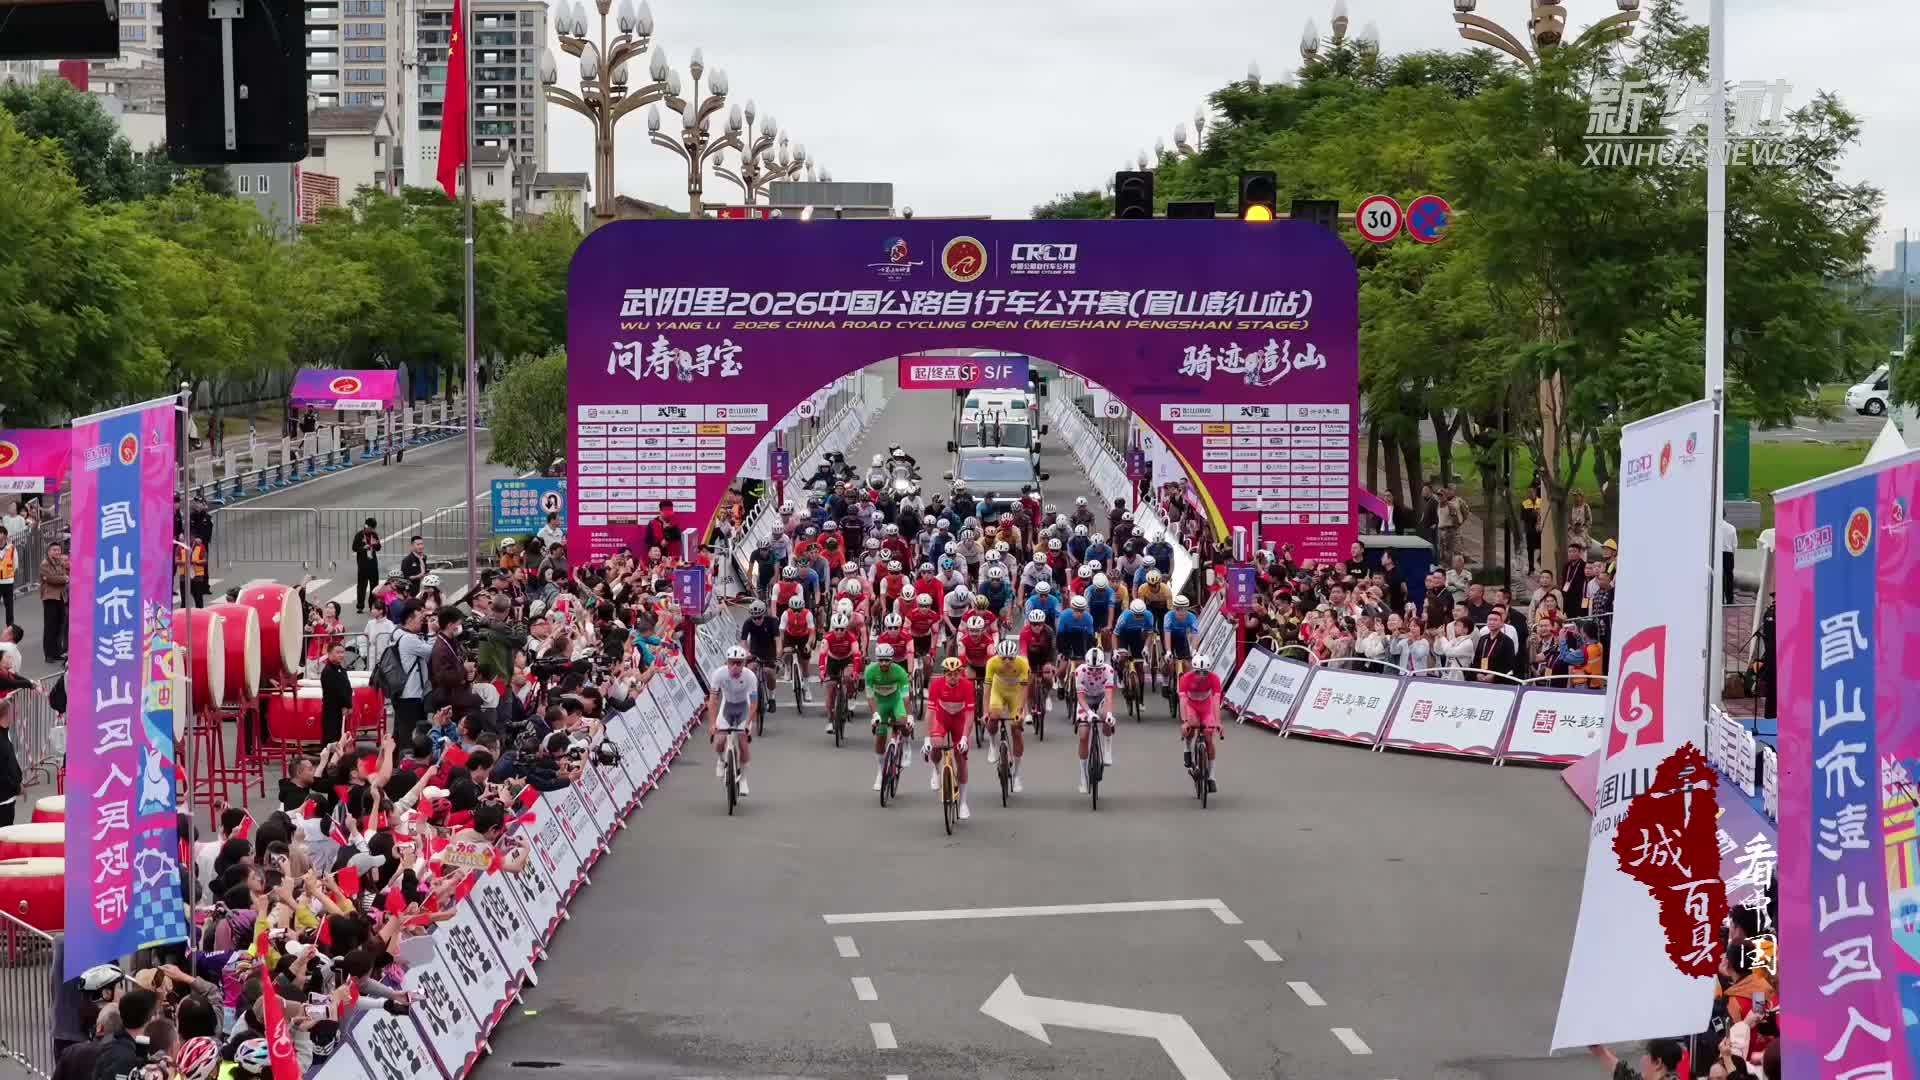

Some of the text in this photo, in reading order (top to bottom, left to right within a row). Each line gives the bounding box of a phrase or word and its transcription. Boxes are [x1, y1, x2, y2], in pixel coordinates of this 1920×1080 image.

[1367, 210, 1392, 229] 30
[619, 286, 1314, 319] 武阳里2026中国公路自行车公开赛(眉山彭山站)
[620, 319, 1310, 331] WU YANG LI 2026 CHINA ROAD CYCLING OPEN (MEISHAN PENGSHAN STAGE)
[914, 366, 957, 381] 起/终点
[984, 365, 1014, 380] S/F
[800, 404, 812, 416] 50
[1108, 404, 1121, 416] 50
[1434, 705, 1495, 722] 兴彭集团
